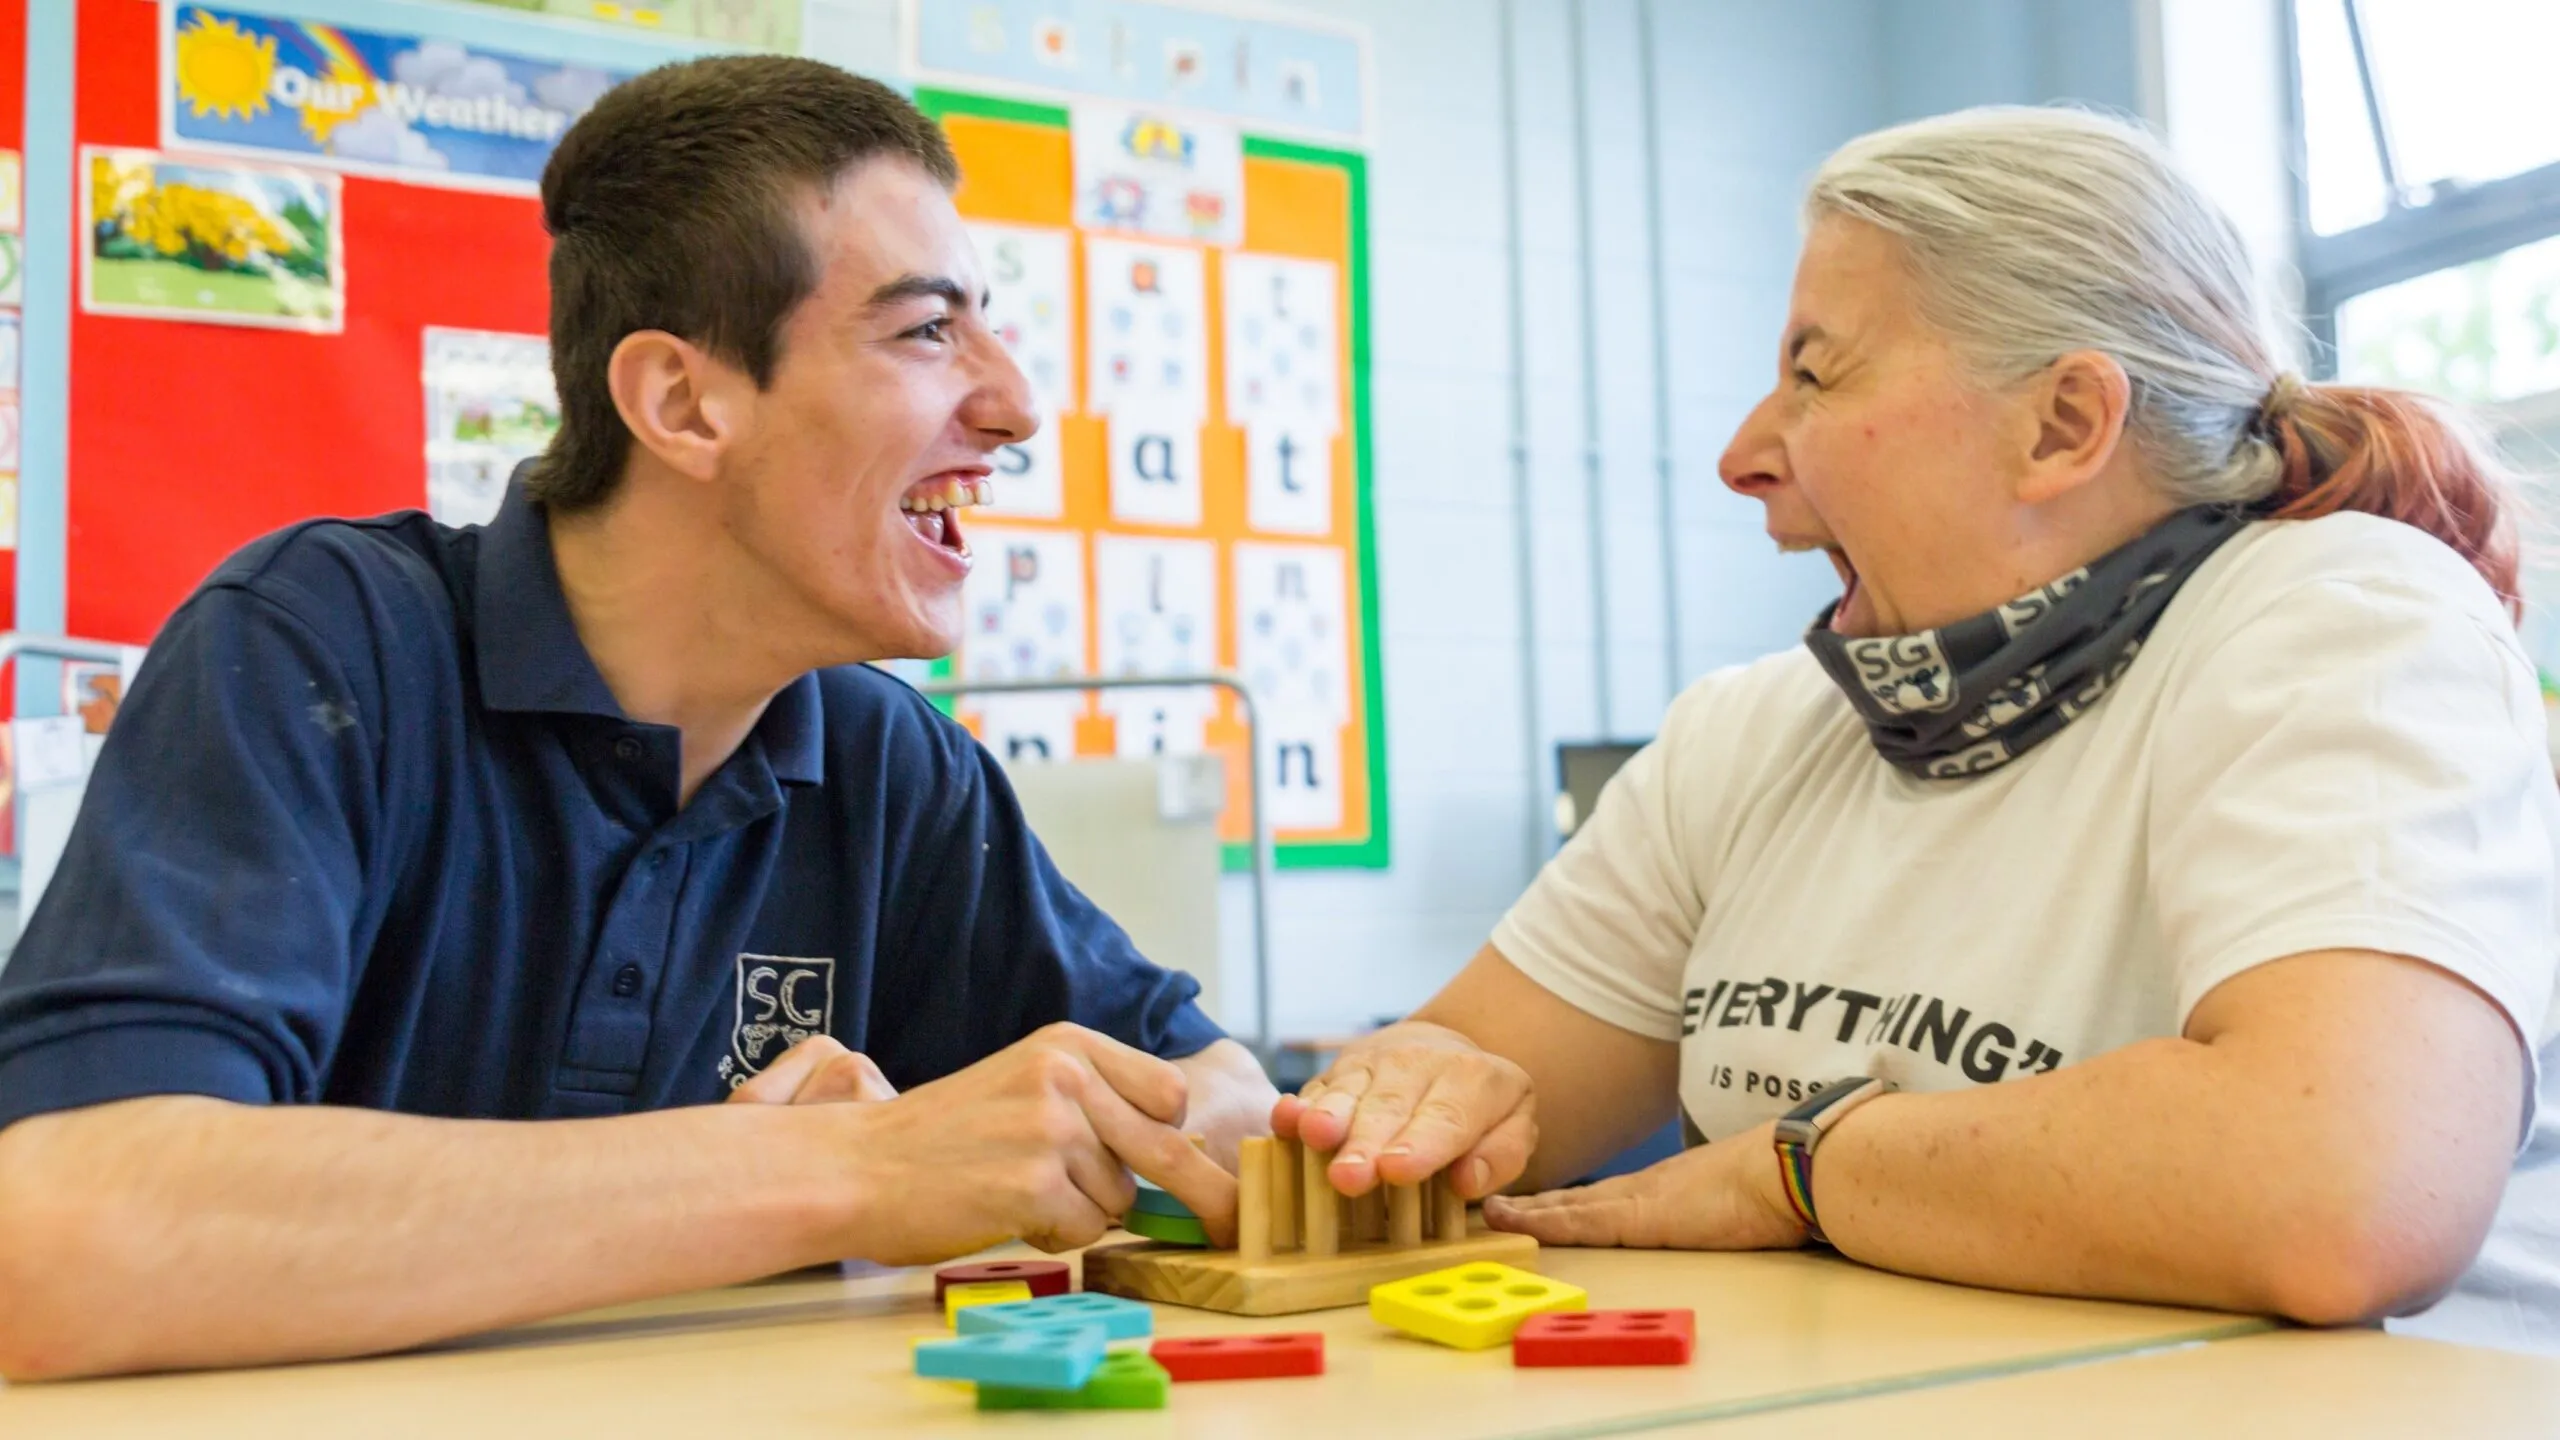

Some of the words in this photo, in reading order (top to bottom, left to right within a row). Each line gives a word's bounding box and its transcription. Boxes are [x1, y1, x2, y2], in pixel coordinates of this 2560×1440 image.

[272, 66, 364, 114] Our
[376, 80, 566, 140] Weather
[1133, 433, 1177, 484] a
[1276, 433, 1302, 493] t
[1005, 546, 1038, 602] p
[1855, 635, 1932, 680] SG
[1278, 741, 1319, 788] n
[746, 966, 822, 1026] SG
[1710, 1064, 1733, 1090] IS
